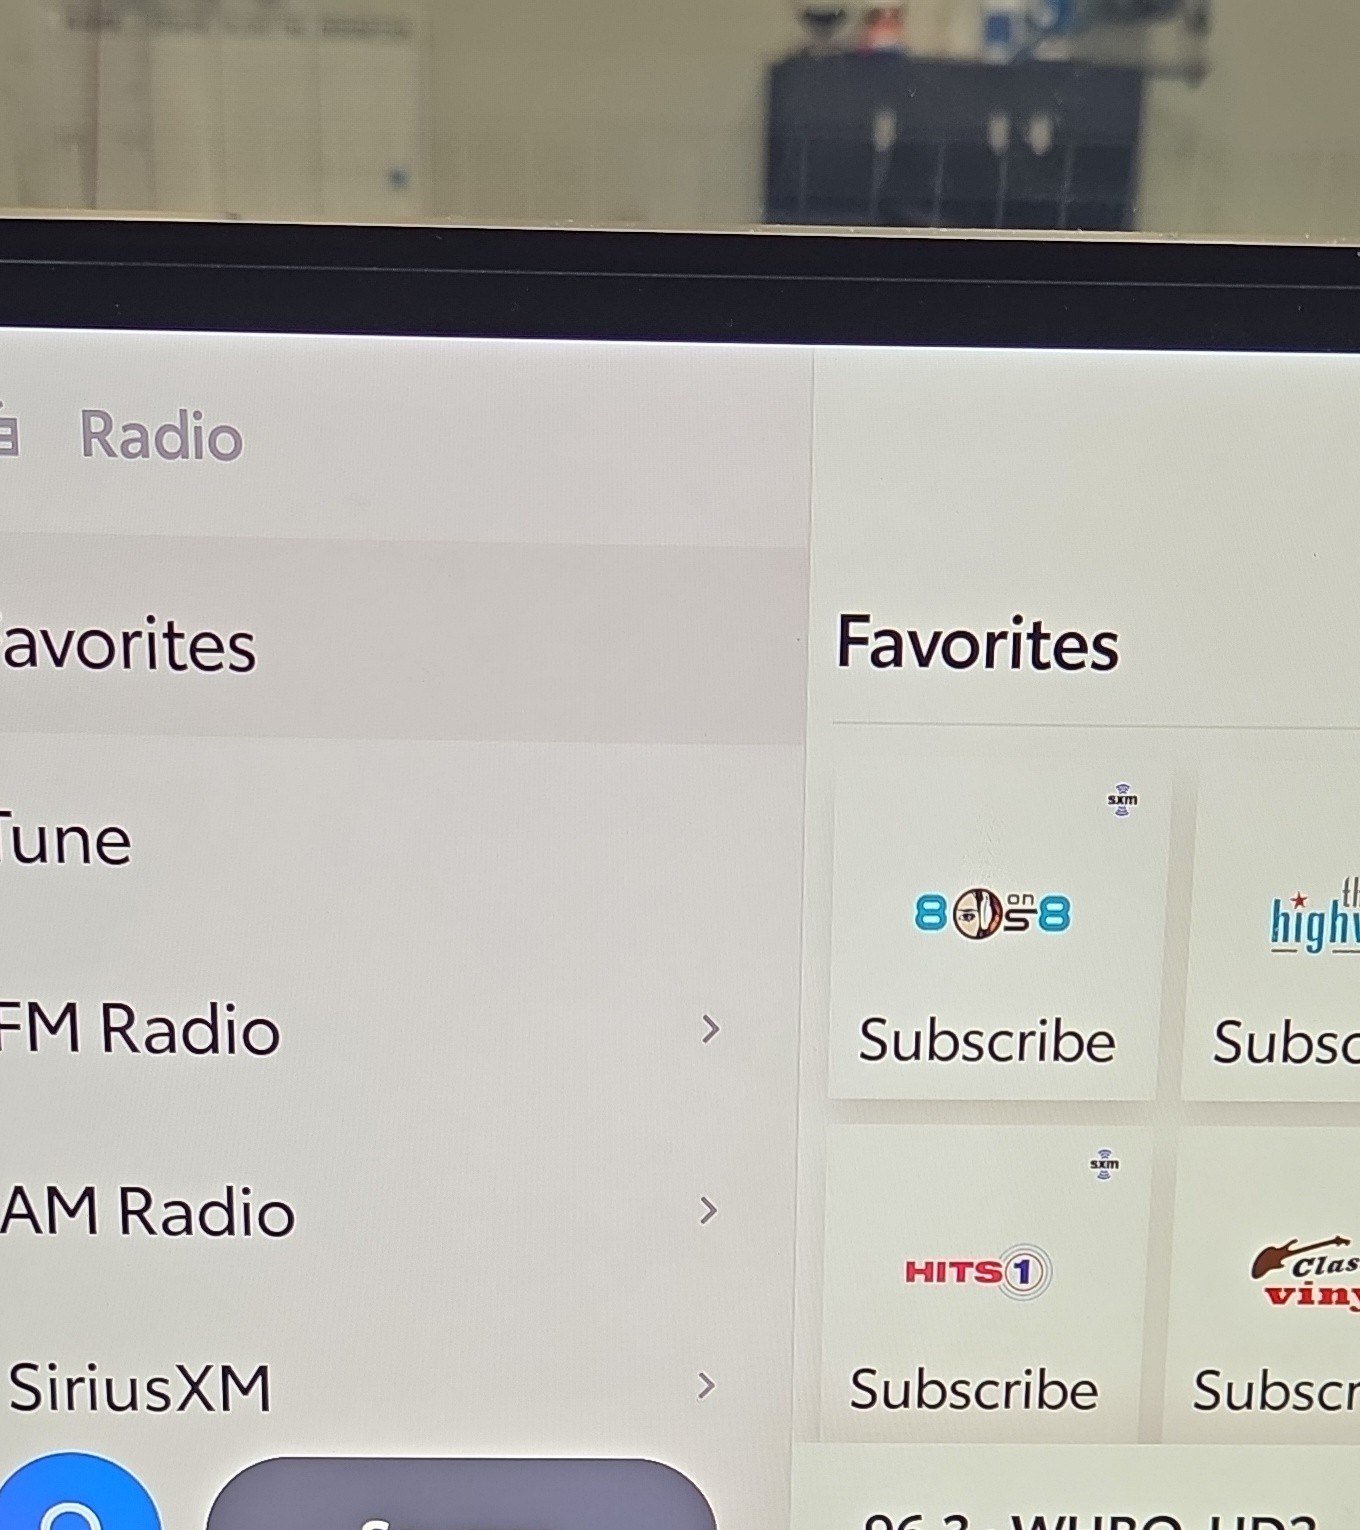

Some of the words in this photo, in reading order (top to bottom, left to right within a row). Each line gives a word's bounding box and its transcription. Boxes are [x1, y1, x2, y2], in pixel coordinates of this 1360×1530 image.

[82, 409, 242, 461] Radio
[840, 614, 1118, 670] Favorites
[103, 1002, 279, 1055] Radio
[860, 1017, 1115, 1062] Subscribe
[0, 1186, 96, 1234] AM
[121, 1186, 294, 1237] Radio
[905, 1260, 1003, 1283] HITS
[11, 1363, 269, 1411] SiriusXM
[851, 1367, 1098, 1410] Subscribe
